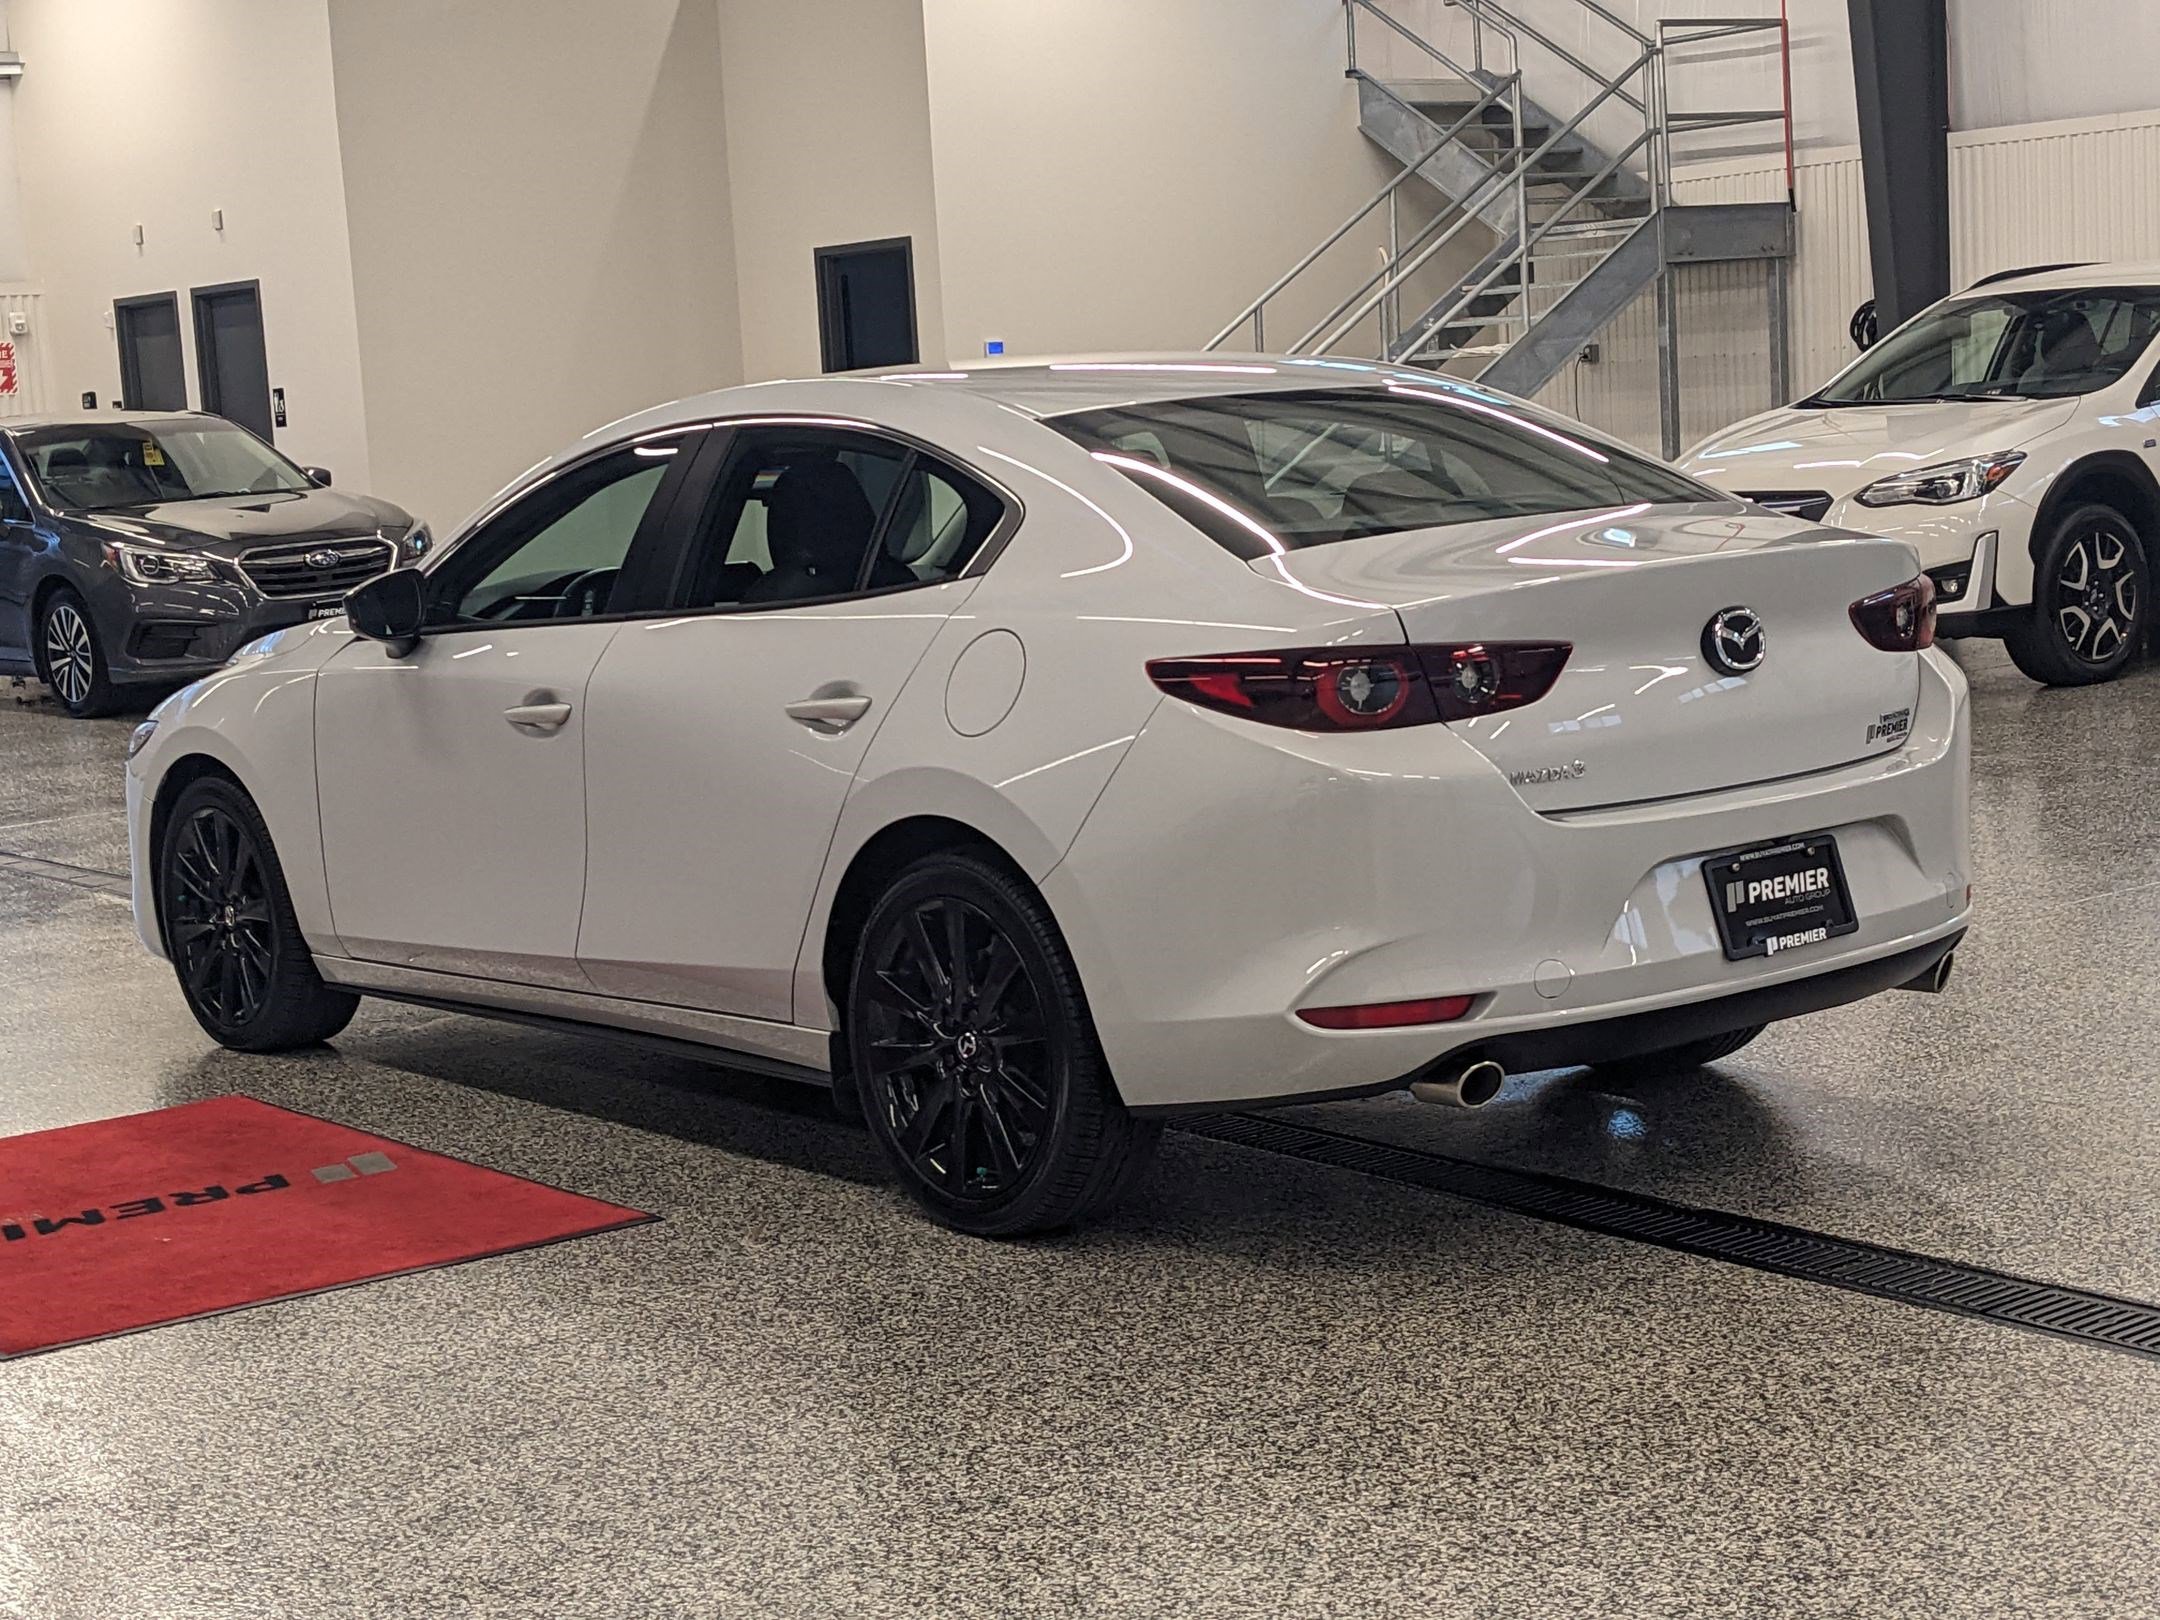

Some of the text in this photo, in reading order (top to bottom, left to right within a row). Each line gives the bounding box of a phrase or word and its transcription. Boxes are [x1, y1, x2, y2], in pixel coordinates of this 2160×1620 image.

[1748, 867, 1830, 904] PREMIER
[1785, 888, 1831, 905] AUTO GROUP
[1779, 927, 1827, 950] PREMIER
